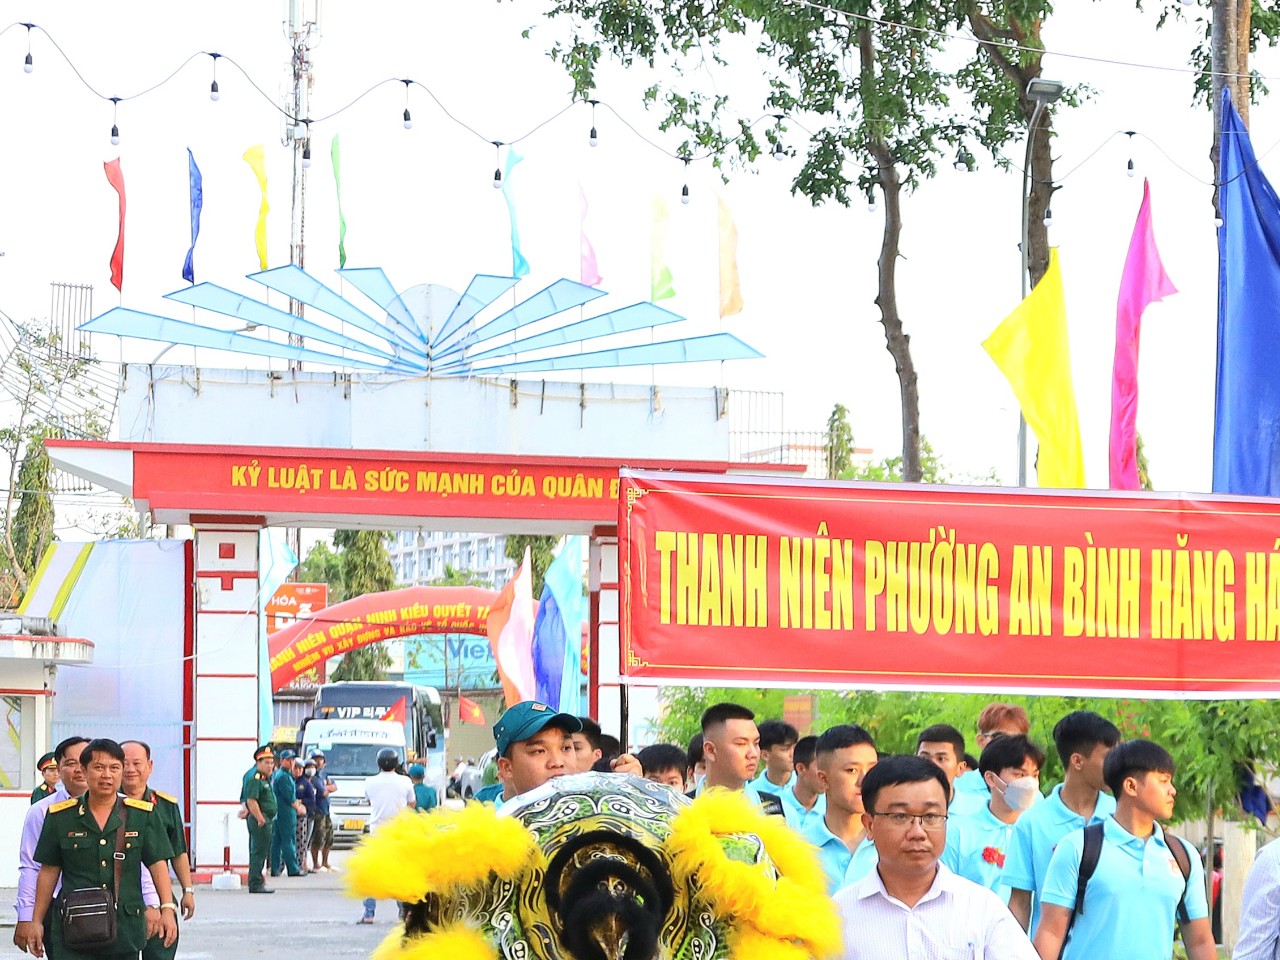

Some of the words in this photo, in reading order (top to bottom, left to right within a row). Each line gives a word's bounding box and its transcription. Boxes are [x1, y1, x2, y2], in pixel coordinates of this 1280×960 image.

[232, 460, 262, 487] KỶ
[268, 464, 324, 494] LUẬT
[330, 466, 358, 491] LÀ
[365, 467, 410, 493] SỨC
[416, 472, 485, 497] MẠNH
[491, 469, 536, 497] CỦA
[543, 474, 604, 499] QUÂN
[656, 530, 768, 628] THANH
[779, 522, 854, 631] NIÊN
[865, 525, 999, 636] PHƯỜNG
[1009, 544, 1053, 637] AN
[1063, 532, 1141, 639] BÌNH
[1151, 538, 1236, 642] HĂNG
[295, 630, 327, 655] NIÊN
[366, 609, 397, 625] NINH
[432, 602, 472, 619] QUYẾT
[337, 706, 361, 719] VIP
